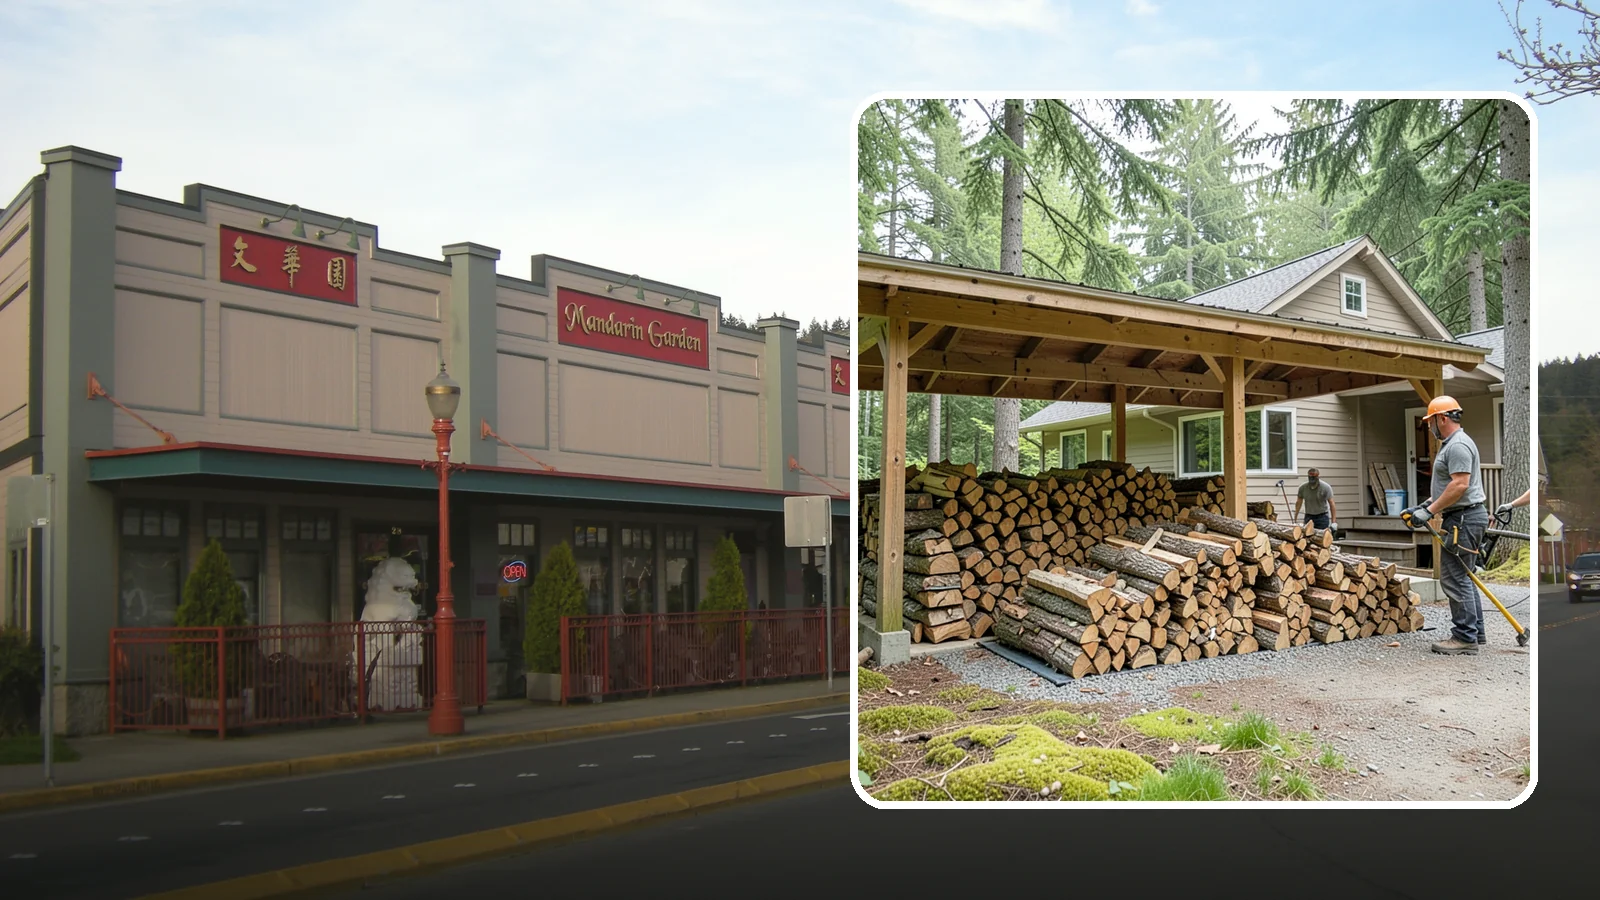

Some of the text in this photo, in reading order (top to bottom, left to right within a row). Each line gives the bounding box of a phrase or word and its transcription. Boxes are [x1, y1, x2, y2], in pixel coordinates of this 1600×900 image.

[564, 302, 701, 352] Mandarin Garden
[503, 565, 527, 578] OPEN
